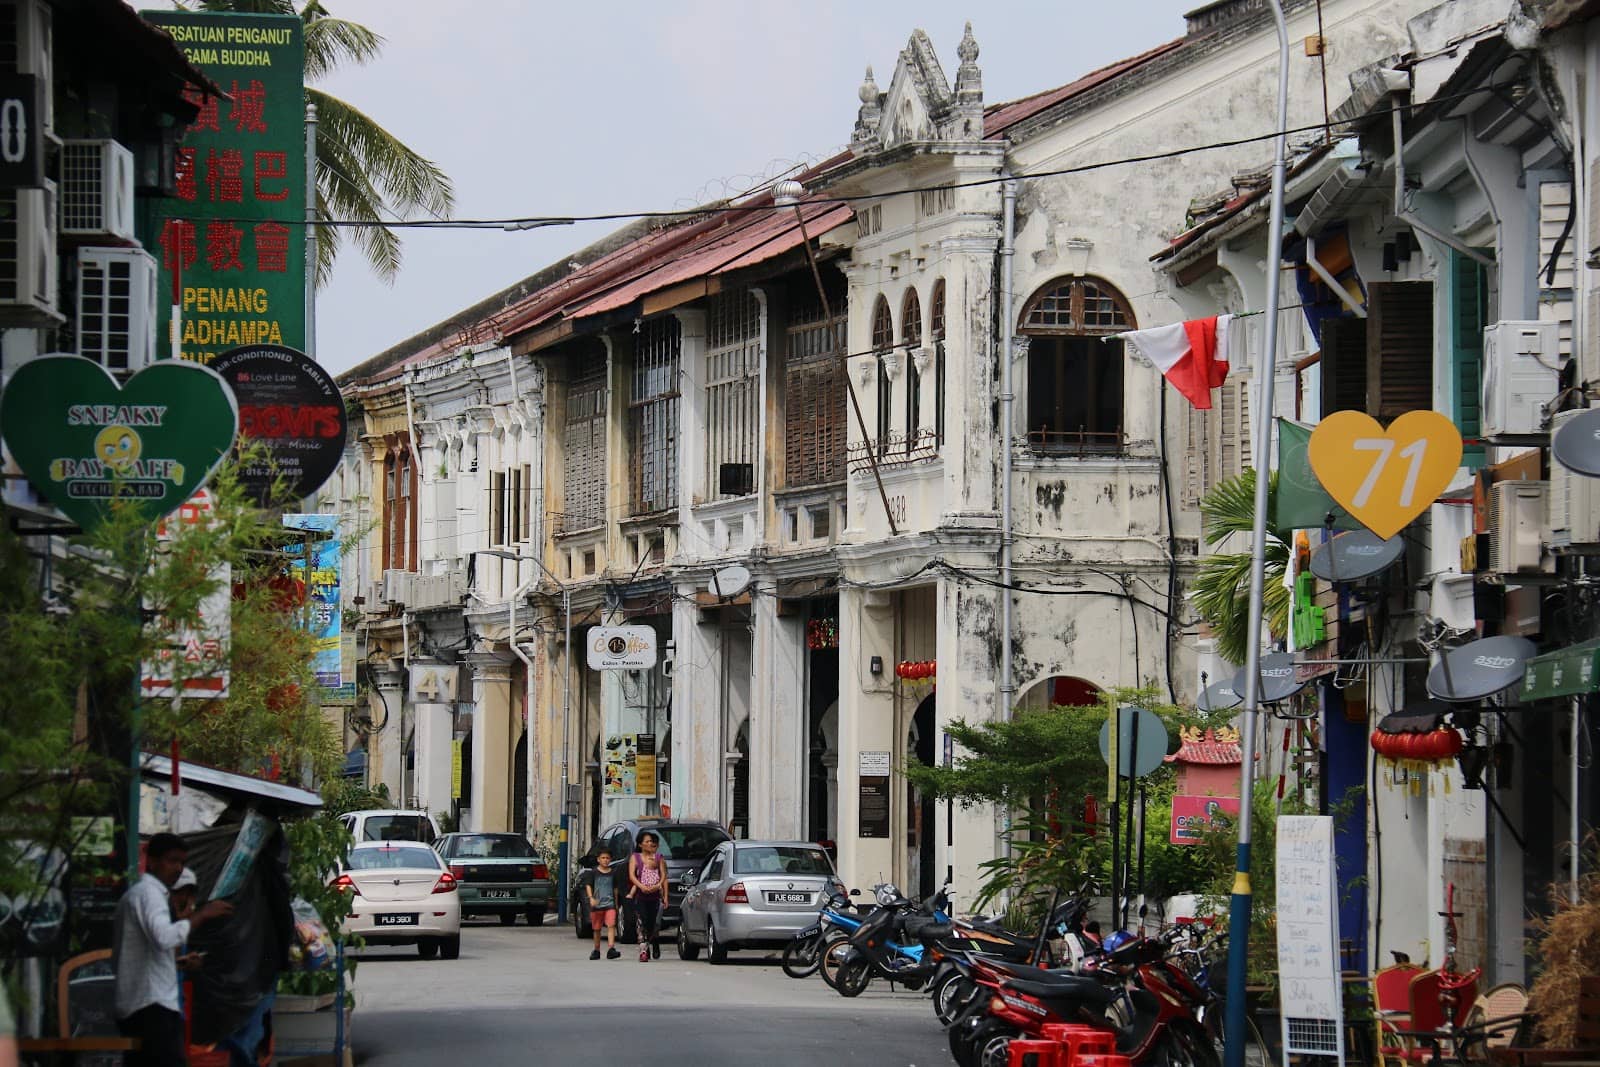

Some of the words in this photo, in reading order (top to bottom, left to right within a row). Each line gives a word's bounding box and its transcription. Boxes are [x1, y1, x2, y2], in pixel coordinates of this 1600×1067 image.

[161, 25, 225, 42] RSATUAN
[227, 27, 292, 45] PENGANUT
[184, 47, 219, 65] GAMA
[221, 49, 272, 67] BUDDHA
[183, 287, 269, 314] PENANG
[251, 372, 273, 383] Love
[274, 372, 297, 383] Lane
[67, 405, 168, 427] SNEAKY
[60, 458, 105, 479] BAY
[1352, 437, 1428, 508] 71
[1473, 655, 1516, 669] astro
[1260, 667, 1293, 678] astro
[416, 670, 458, 701] 41
